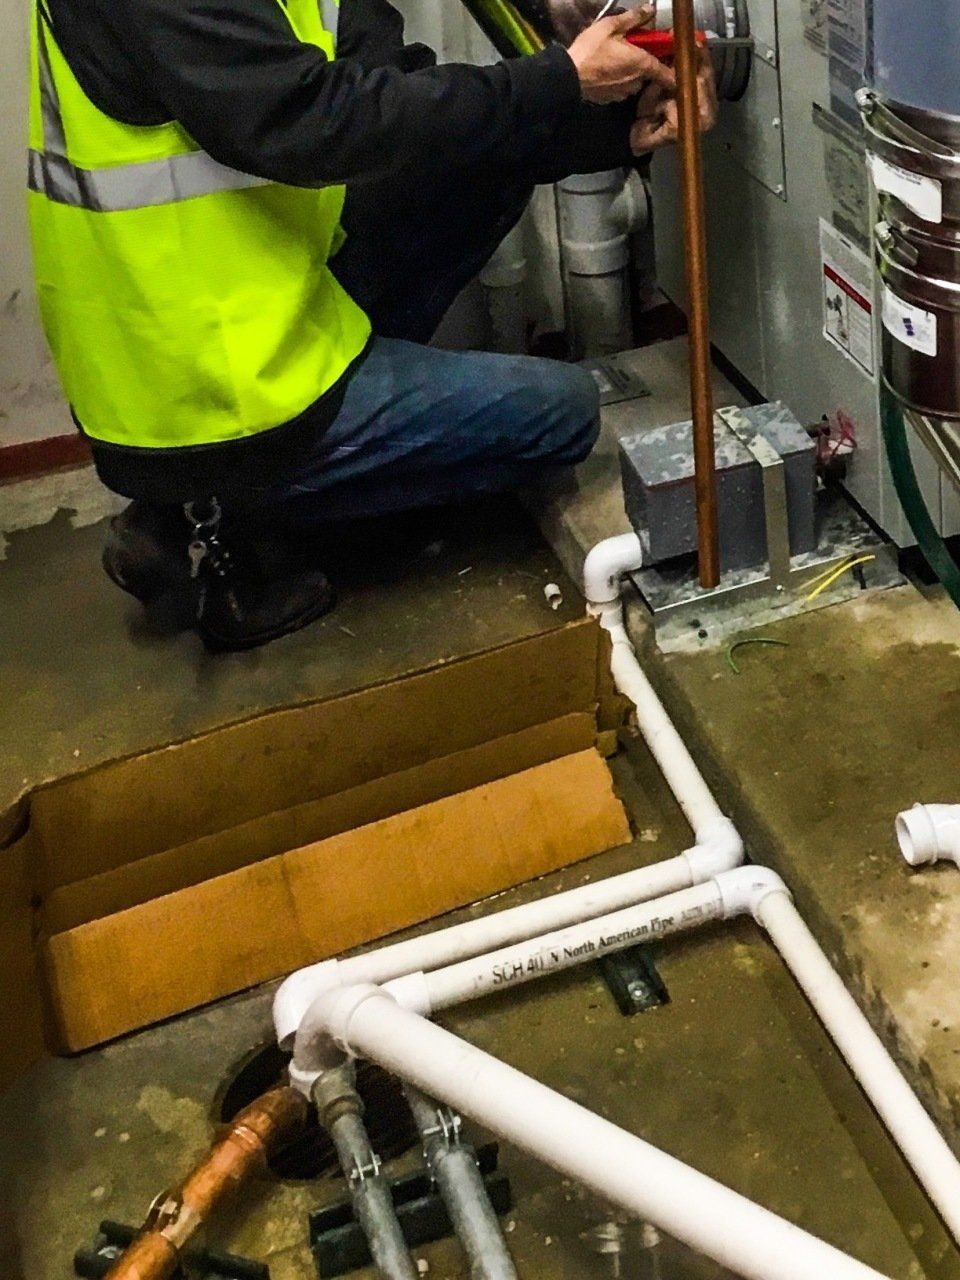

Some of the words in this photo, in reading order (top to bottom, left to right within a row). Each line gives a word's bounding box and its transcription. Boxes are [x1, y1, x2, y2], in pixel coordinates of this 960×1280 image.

[563, 939, 596, 958] North
[600, 924, 649, 948] American
[650, 915, 675, 933] Pipe
